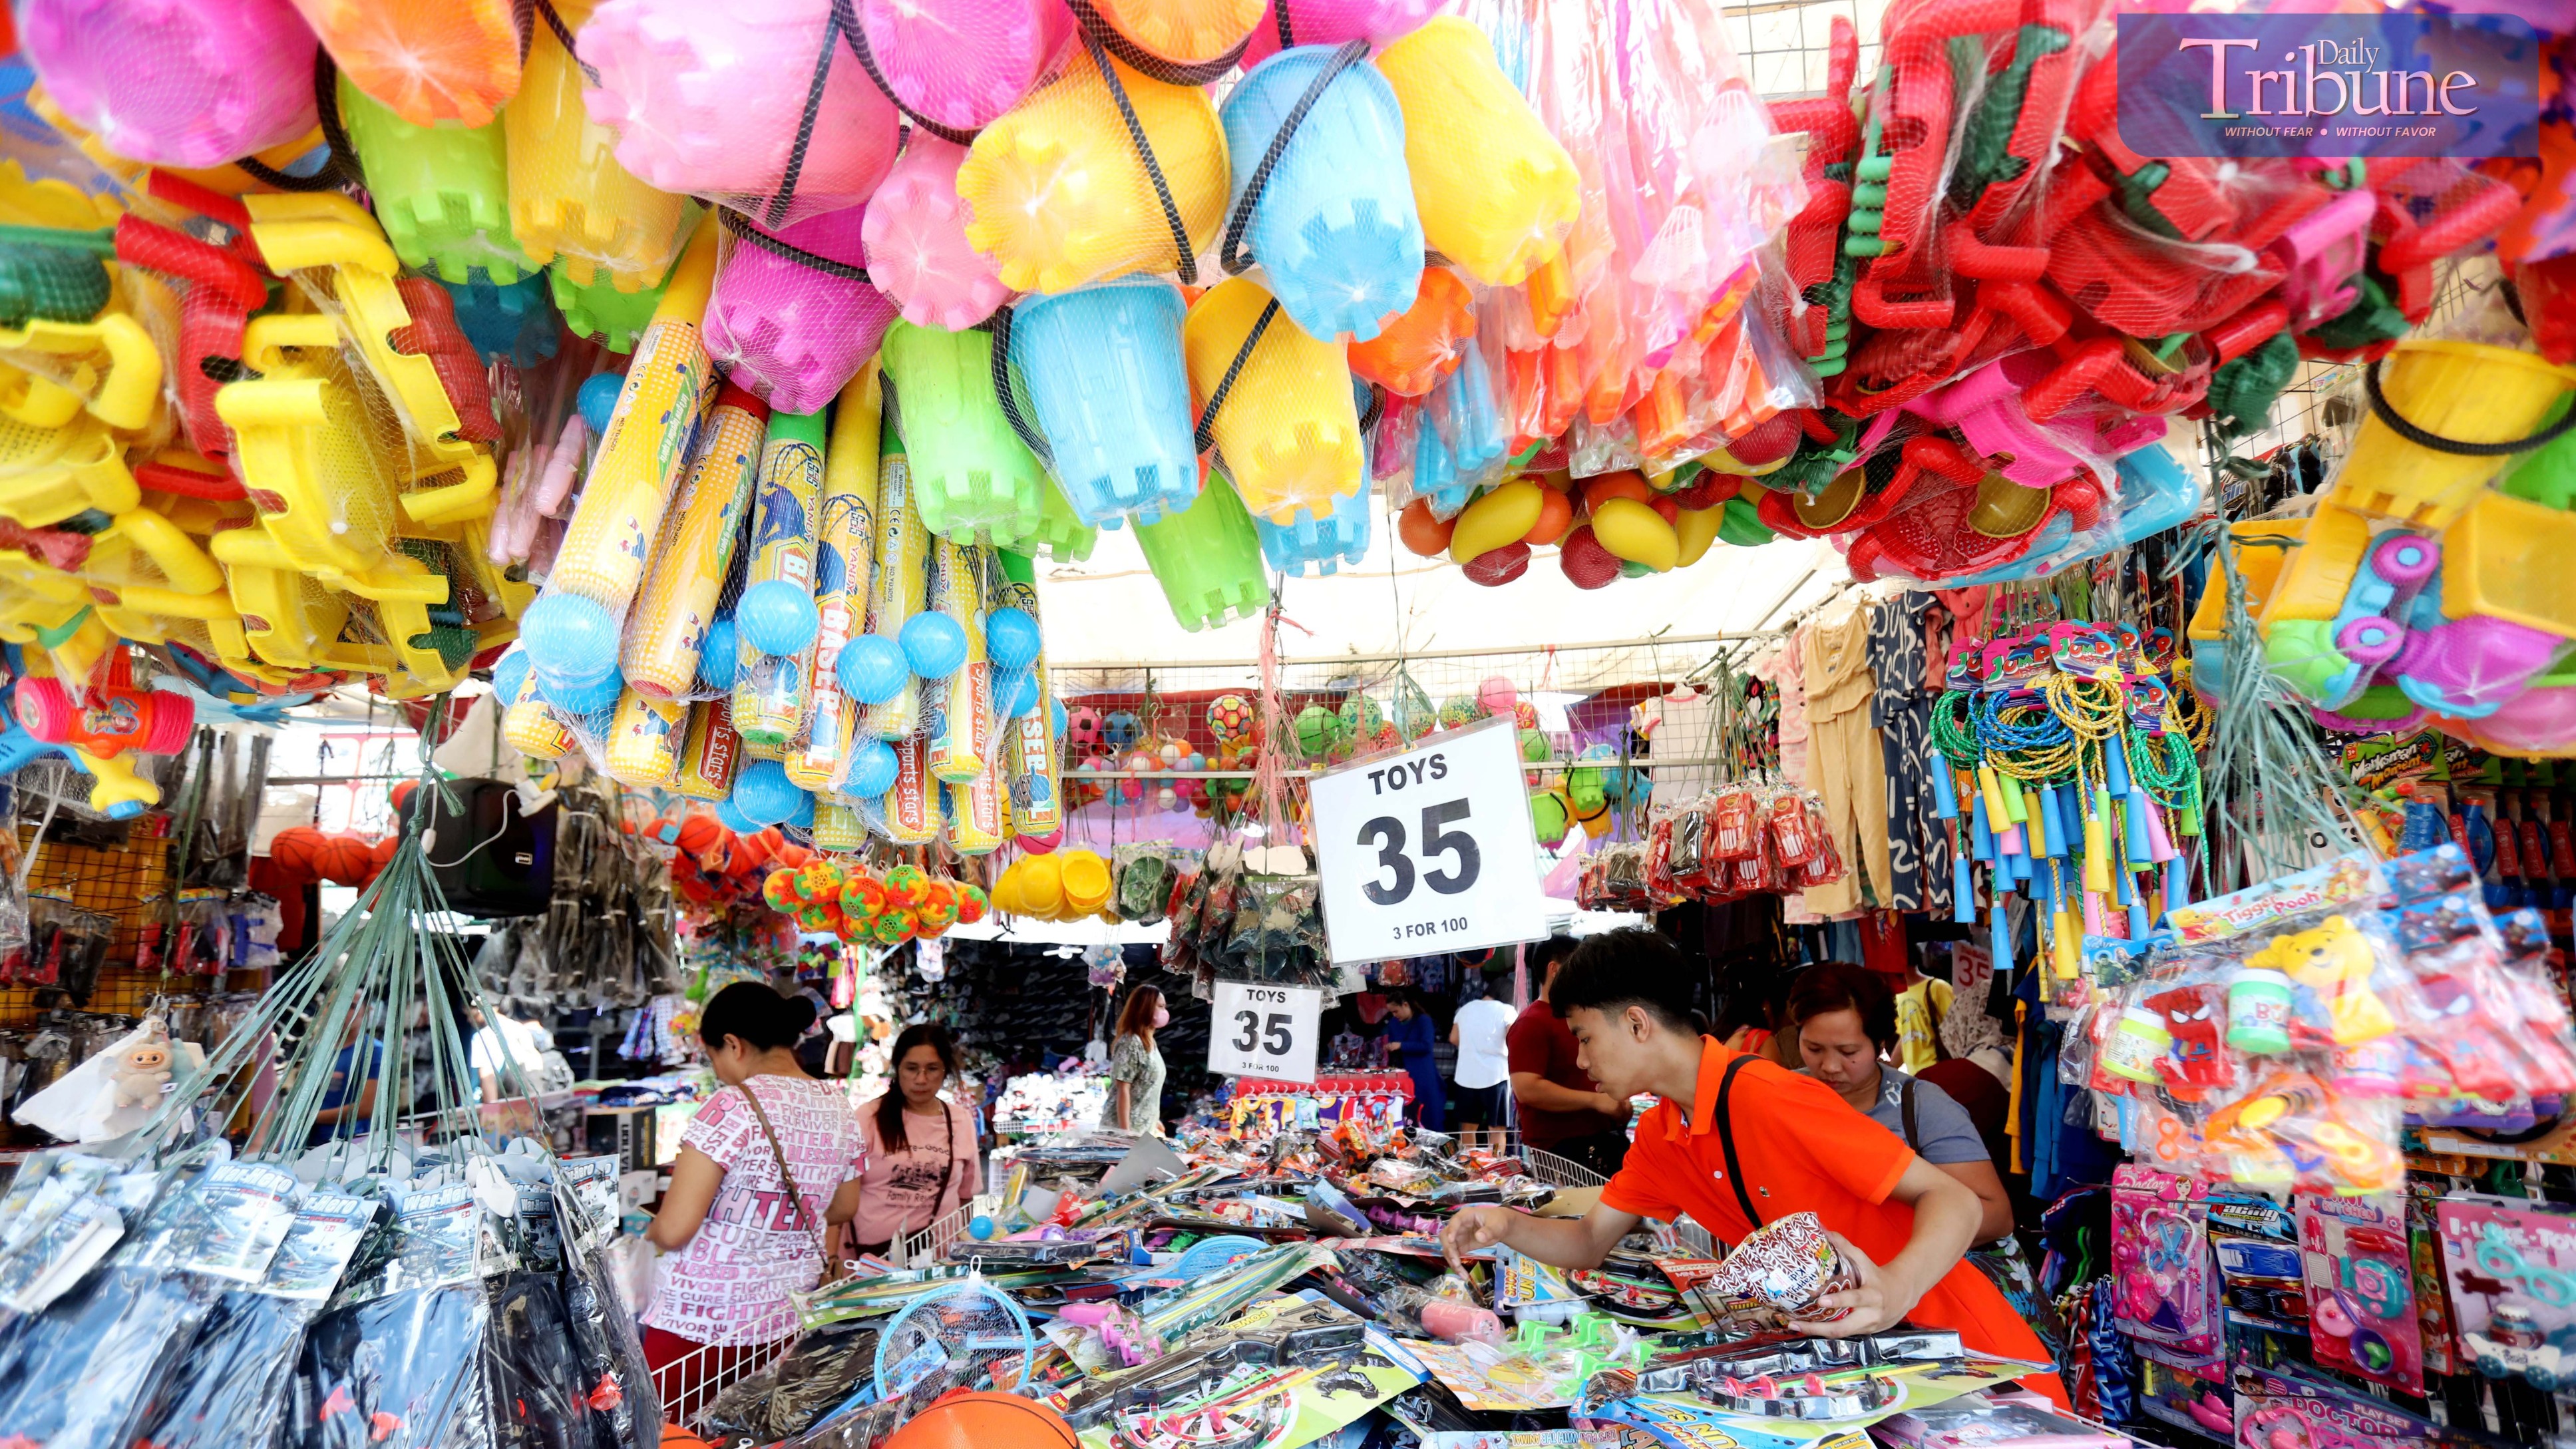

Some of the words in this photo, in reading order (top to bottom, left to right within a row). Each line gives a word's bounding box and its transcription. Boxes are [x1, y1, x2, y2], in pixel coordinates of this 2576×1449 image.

[804, 495, 816, 545] YANDY
[845, 546, 860, 597] YANDY
[2056, 636, 2114, 660] JUMP
[1987, 645, 2050, 683] JUMP
[972, 668, 986, 715] Sports
[2127, 687, 2165, 716] JUMP
[974, 715, 986, 755] stars
[707, 739, 729, 782] stars
[2350, 742, 2417, 784] Marksman
[2421, 765, 2436, 774] GAME
[1368, 753, 1448, 795] TOYS
[903, 785, 920, 824] stars
[981, 789, 996, 829] stars
[1356, 797, 1481, 906] 35
[1393, 927, 1402, 940] 3
[1405, 922, 1437, 938] FOR
[1441, 917, 1469, 934] 100
[1958, 954, 1990, 988] 35
[1246, 988, 1286, 1004] TOYS
[1232, 1010, 1293, 1056] 35
[780, 1104, 839, 1122] FIGHTER
[782, 1116, 838, 1132] SURVIVOR
[301, 1195, 359, 1216] r-Hero
[520, 1198, 552, 1212] War-Hero
[1270, 1201, 1296, 1211] SPEED
[2209, 1203, 2280, 1223] Racing
[2322, 1200, 2376, 1221] KITCHEN
[702, 1221, 779, 1250] CURE
[2217, 1225, 2263, 1241] SUPER
[1520, 1256, 1536, 1277] SET
[1505, 1267, 1517, 1297] SHOOT
[1791, 1273, 1817, 1294] Happy
[680, 1292, 724, 1305] CURE
[1638, 1403, 1698, 1422] SET
[2291, 1396, 2400, 1446] DOCTOR
[2353, 1402, 2384, 1420] PLAY
[2386, 1414, 2410, 1429] SET
[1511, 1432, 1540, 1446] ANIMAL
[1541, 1432, 1556, 1444] THE
[1556, 1431, 1578, 1444] WITH
[1686, 1422, 1738, 1449] UN
